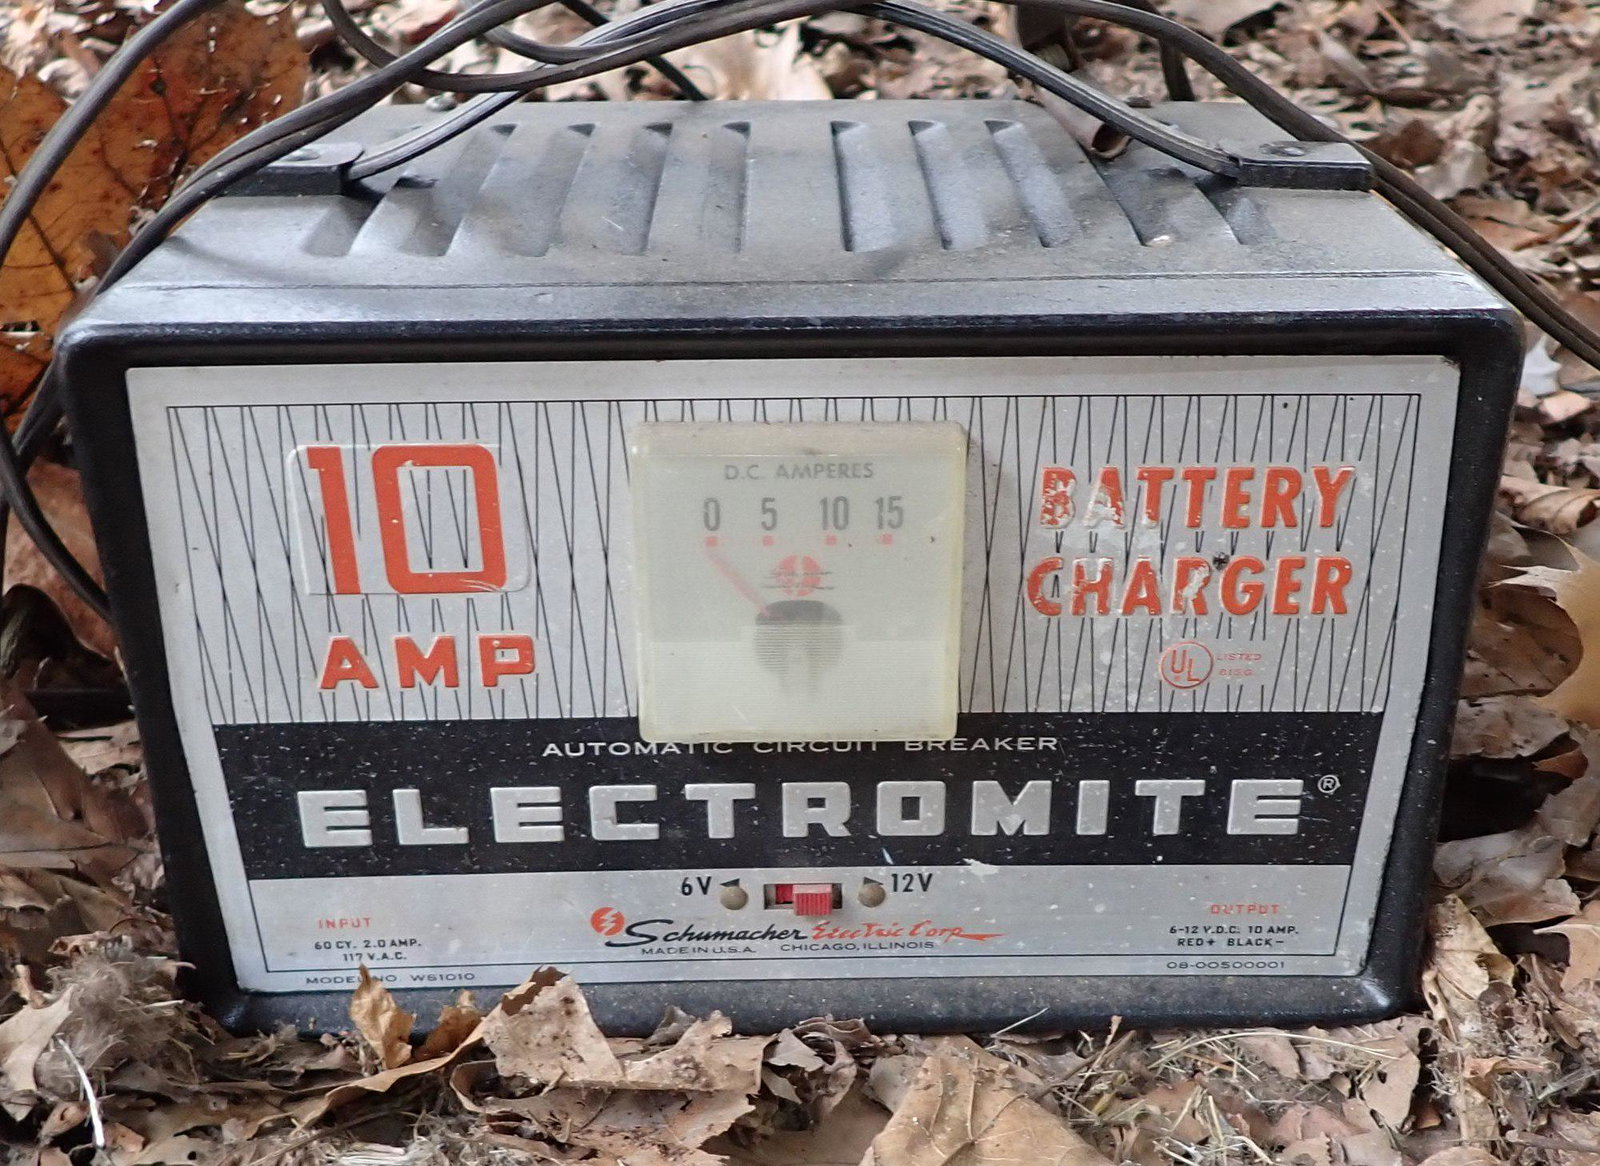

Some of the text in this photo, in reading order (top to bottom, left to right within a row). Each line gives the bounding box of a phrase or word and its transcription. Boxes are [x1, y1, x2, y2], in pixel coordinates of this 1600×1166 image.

[776, 462, 874, 479] AMPERES
[1040, 466, 1355, 529] BATTERY
[306, 446, 507, 594] 10
[703, 496, 904, 531] 0 5 10 15
[1027, 556, 1353, 616] CHARGER
[320, 635, 536, 689] AMP
[1166, 646, 1207, 685] UL
[542, 741, 733, 757] AUTOMATIC
[904, 737, 1058, 752] BREAKER
[297, 779, 1304, 848] ELECTROMITE
[680, 873, 932, 896] 6V 12V
[1210, 904, 1280, 915] OUTPUT
[318, 917, 371, 930] INPUT
[605, 919, 807, 947] Schumacher
[1169, 926, 1199, 934] 6-12
[1248, 925, 1263, 934] 10
[1266, 925, 1299, 934] AMP.
[314, 941, 332, 950] 60
[363, 939, 386, 949] 2.0
[390, 938, 422, 948] AMP.
[780, 940, 935, 952] CHICAGO, ILLINOIS
[343, 953, 363, 962] 117
[1166, 961, 1285, 969] 08-00500001
